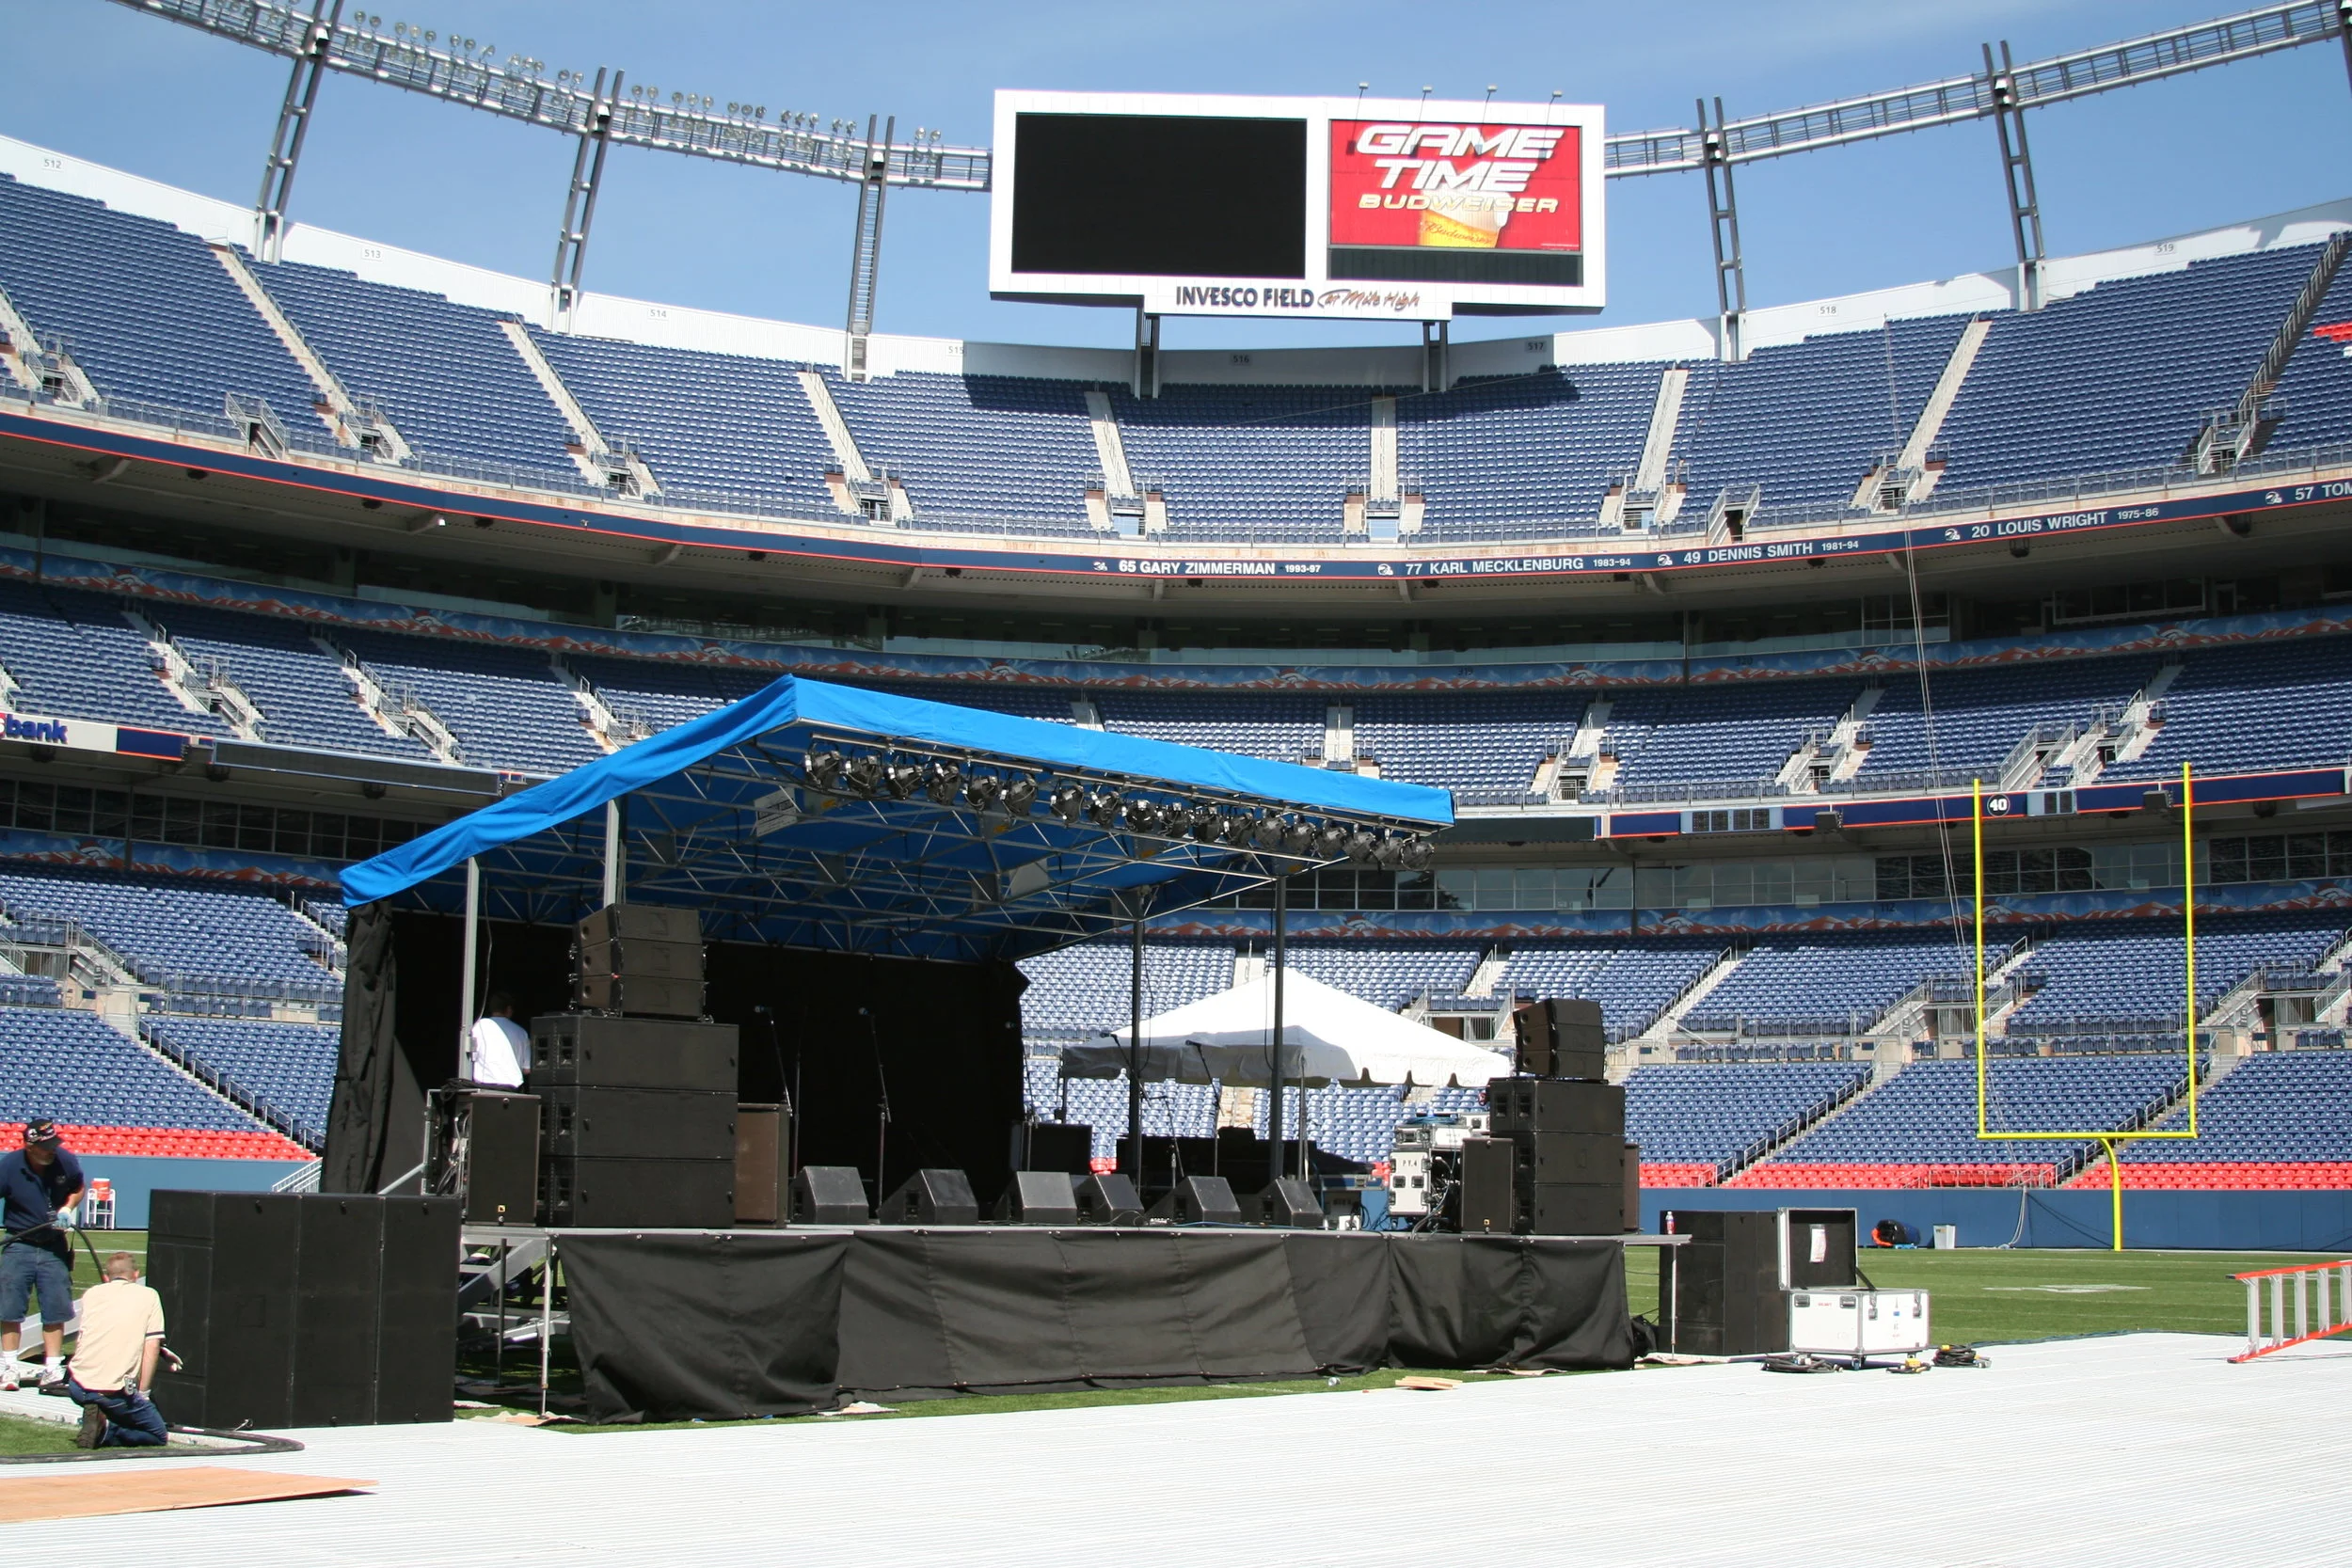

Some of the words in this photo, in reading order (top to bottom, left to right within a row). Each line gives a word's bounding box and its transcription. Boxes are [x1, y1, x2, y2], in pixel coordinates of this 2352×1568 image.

[1356, 124, 1564, 159] GAME
[44, 159, 62, 169] 512
[1375, 158, 1538, 192] TIME
[1359, 193, 1559, 214] BUDWEISER
[1424, 221, 1492, 244] Budweiser
[364, 249, 381, 259] 513
[2156, 244, 2174, 253] 519
[1176, 286, 1258, 308] INVESCO
[1263, 288, 1314, 308] FIELD
[1342, 290, 1380, 309] Mile
[1383, 290, 1420, 312] High
[650, 309, 667, 318] 514
[1820, 306, 1836, 314] 518
[948, 345, 964, 355] 515
[1527, 341, 1544, 351] 517
[1232, 355, 1249, 364] 516
[2296, 486, 2313, 500] 57
[1971, 526, 1990, 539] 20
[1997, 519, 2042, 536] LOUIS
[2047, 511, 2107, 531] WRIGHT
[2117, 507, 2159, 520] 1975-86
[1683, 550, 1701, 564] 49
[1708, 546, 1762, 562] DENNIS
[1767, 542, 1813, 558] SMITH
[1821, 540, 1859, 551] 1981-94
[1119, 560, 1136, 573] 65
[1140, 561, 1180, 575] GARY
[1184, 562, 1275, 575] ZIMMERMAN
[1284, 564, 1322, 574] 1993-97
[1406, 563, 1422, 576] 77
[1429, 562, 1468, 575] KARL
[1471, 558, 1583, 573] MECKLENBURG
[1593, 558, 1631, 567] 1983-94
[6, 714, 68, 744] bank
[1989, 798, 2008, 811] 40
